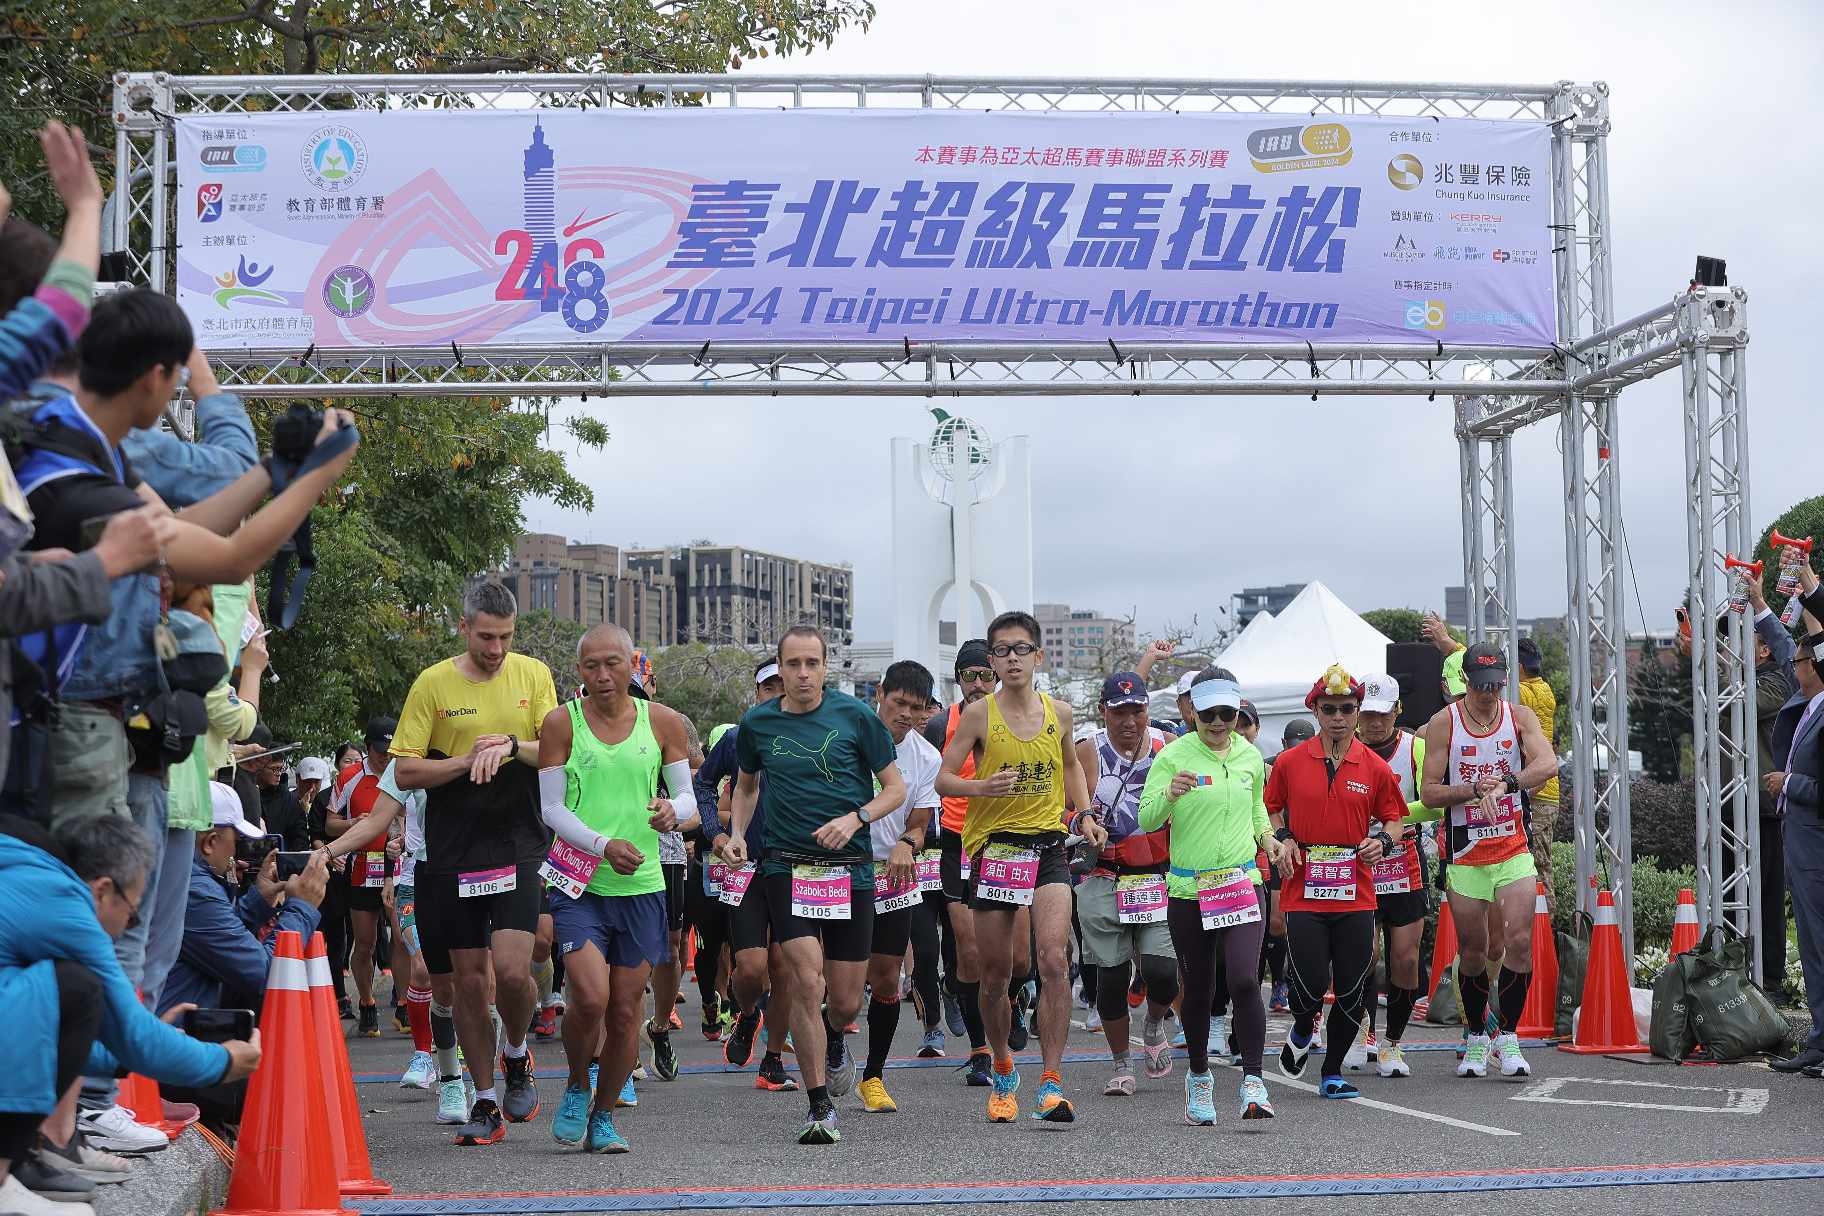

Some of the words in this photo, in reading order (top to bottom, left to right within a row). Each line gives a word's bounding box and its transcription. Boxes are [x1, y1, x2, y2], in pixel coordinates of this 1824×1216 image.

[1389, 130, 1440, 142] 合作單位：
[914, 145, 1230, 169] 本賽事為亞太超馬賽事聯盟系列賽
[1434, 162, 1531, 187] 兆豐保險
[1435, 189, 1465, 202] Chung
[1467, 190, 1485, 201] Kuo
[1487, 191, 1531, 202] Insurance
[286, 195, 385, 213] 教育部體育署
[1450, 212, 1502, 223] KERRY
[666, 179, 1362, 274] 臺北超級馬拉松
[651, 286, 783, 326] 2024
[798, 286, 953, 333] Taipei
[958, 286, 1340, 329] Ultra-Marathon
[201, 316, 313, 331] 臺北市政府體育局
[445, 707, 477, 718] NorDan
[553, 840, 565, 857] Wu
[562, 847, 585, 874] Chung
[582, 860, 597, 878] Fai
[546, 868, 569, 890] 8052
[985, 862, 1007, 879] 須田
[1010, 865, 1033, 882] 由太
[469, 882, 498, 895] 8106
[795, 882, 828, 898] Szabolcs
[828, 884, 848, 898] Beda
[987, 887, 1015, 901] 8015
[1313, 887, 1340, 898] 8277
[1375, 883, 1395, 893] 004
[884, 895, 910, 911] 8055
[802, 906, 831, 917] 8105
[1128, 912, 1153, 923] 8058
[1212, 913, 1241, 927] 8104
